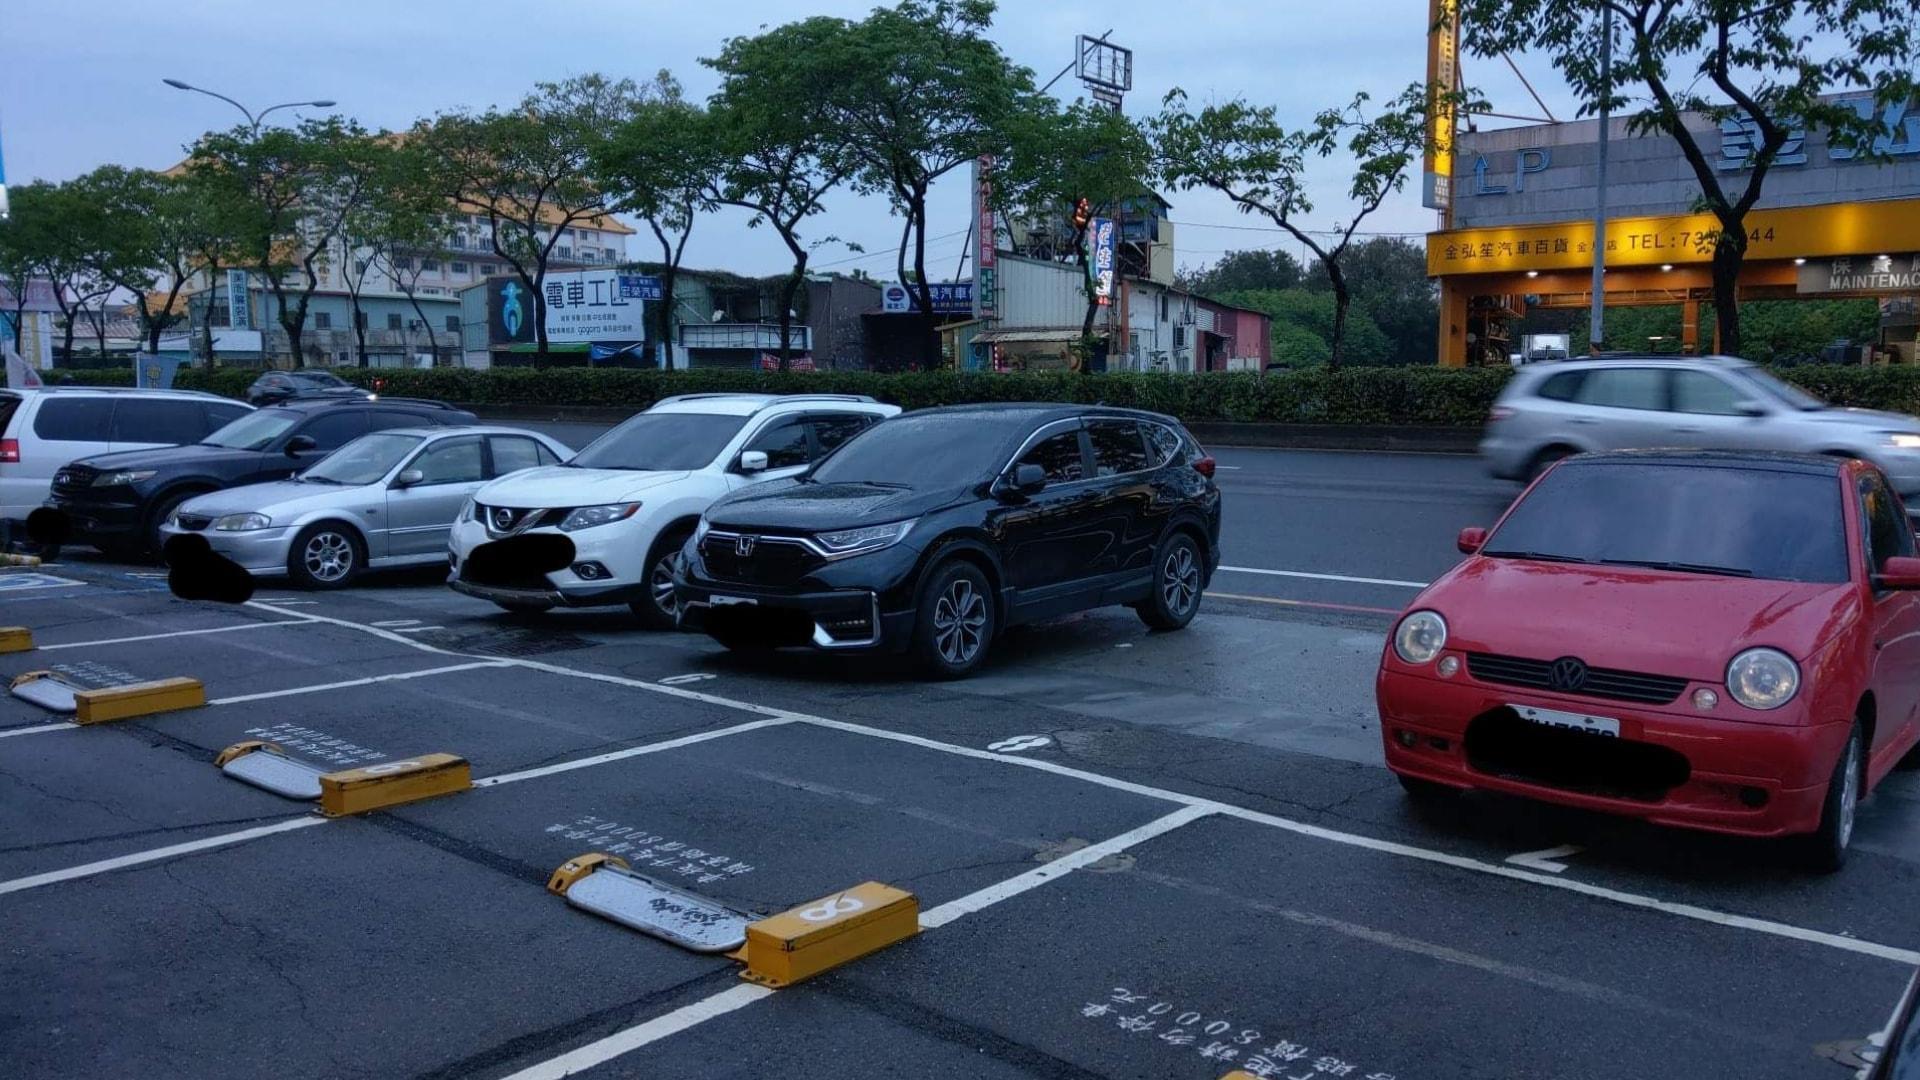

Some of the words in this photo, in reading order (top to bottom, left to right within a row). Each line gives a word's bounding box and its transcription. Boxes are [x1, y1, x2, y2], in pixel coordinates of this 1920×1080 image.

[1445, 238, 1569, 260] 金弘笙汽車百貨
[1577, 240, 1617, 253] 金店
[1628, 227, 1775, 249] TEL:7344
[987, 735, 1051, 752] 8
[798, 895, 864, 923] 8
